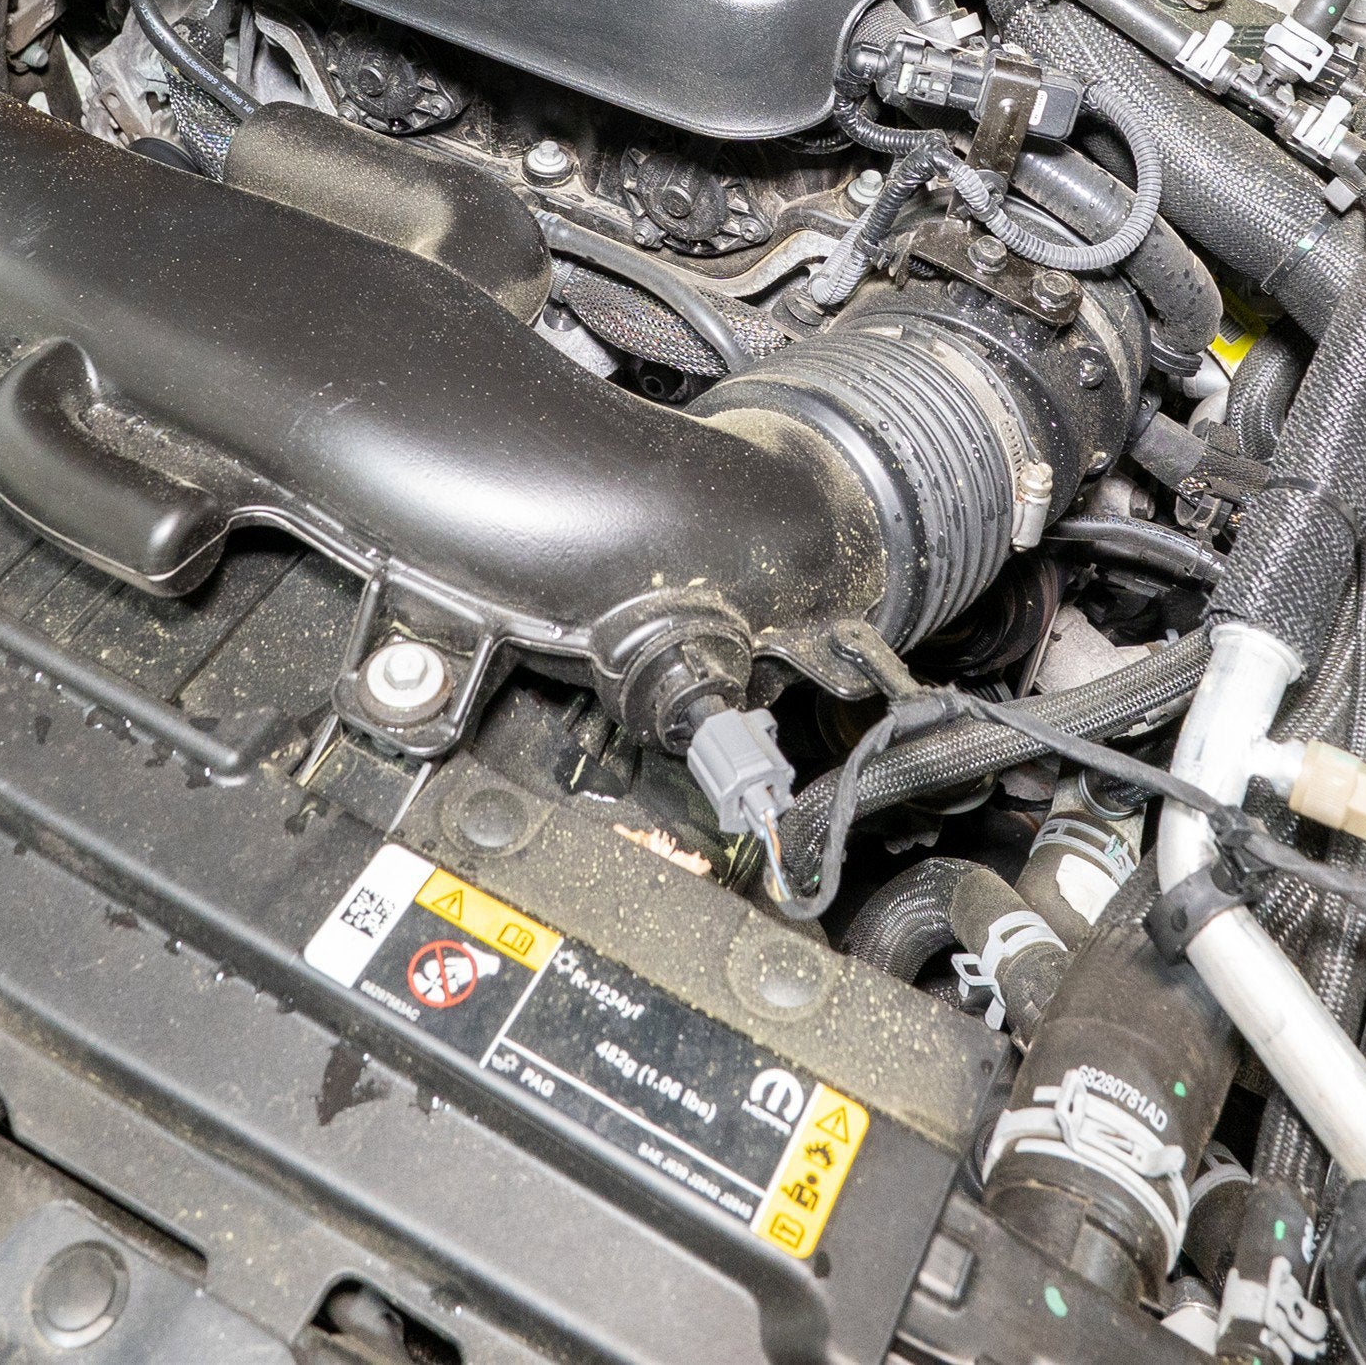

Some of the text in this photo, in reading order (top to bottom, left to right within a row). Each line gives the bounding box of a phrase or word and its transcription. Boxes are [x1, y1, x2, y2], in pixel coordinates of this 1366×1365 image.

[219, 84, 242, 105] BRAKE
[569, 967, 646, 1021] R-1234yf
[519, 1066, 556, 1098] PAG
[637, 1063, 683, 1101] (1.06
[681, 1088, 718, 1125] lbs)
[1075, 1064, 1169, 1133] 68280781AD
